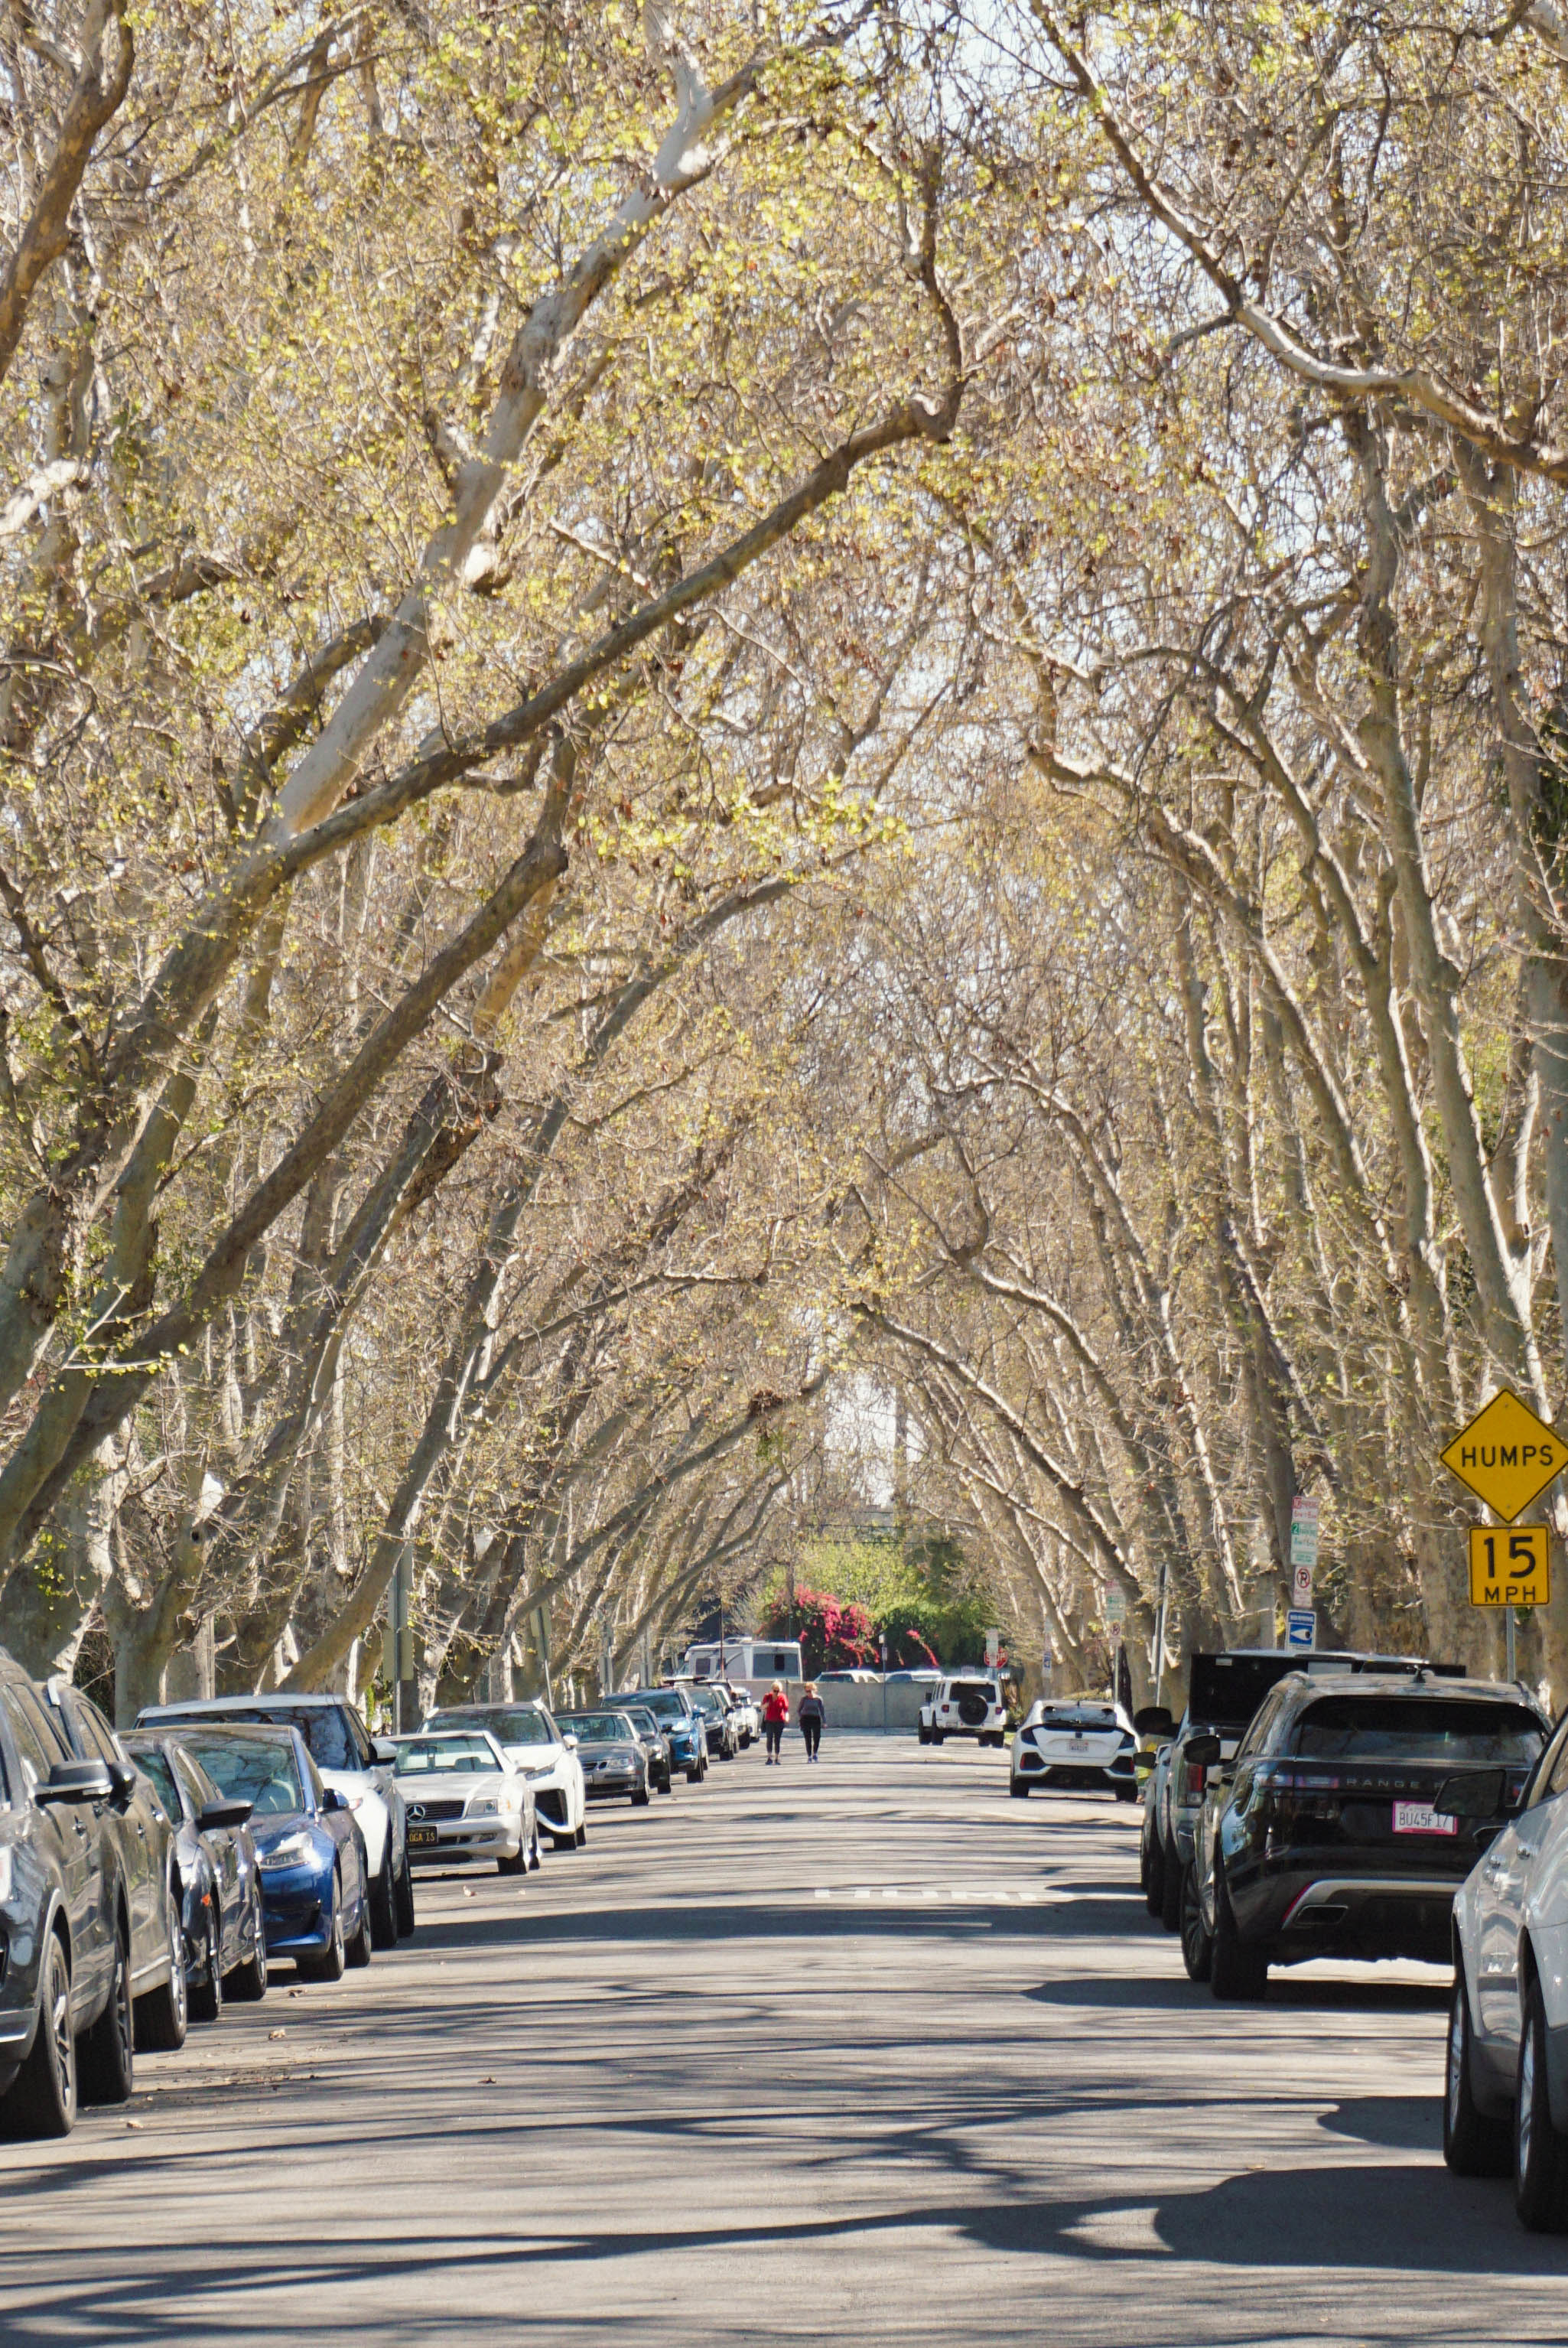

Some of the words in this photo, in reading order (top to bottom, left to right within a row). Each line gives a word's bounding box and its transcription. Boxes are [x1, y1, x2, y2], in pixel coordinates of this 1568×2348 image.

[1462, 1445, 1553, 1467] HUMPS
[1484, 1536, 1536, 1578] 15
[1485, 1586, 1536, 1602] MPH
[1346, 1778, 1420, 1788] RANGE
[407, 1832, 423, 1842] OGA
